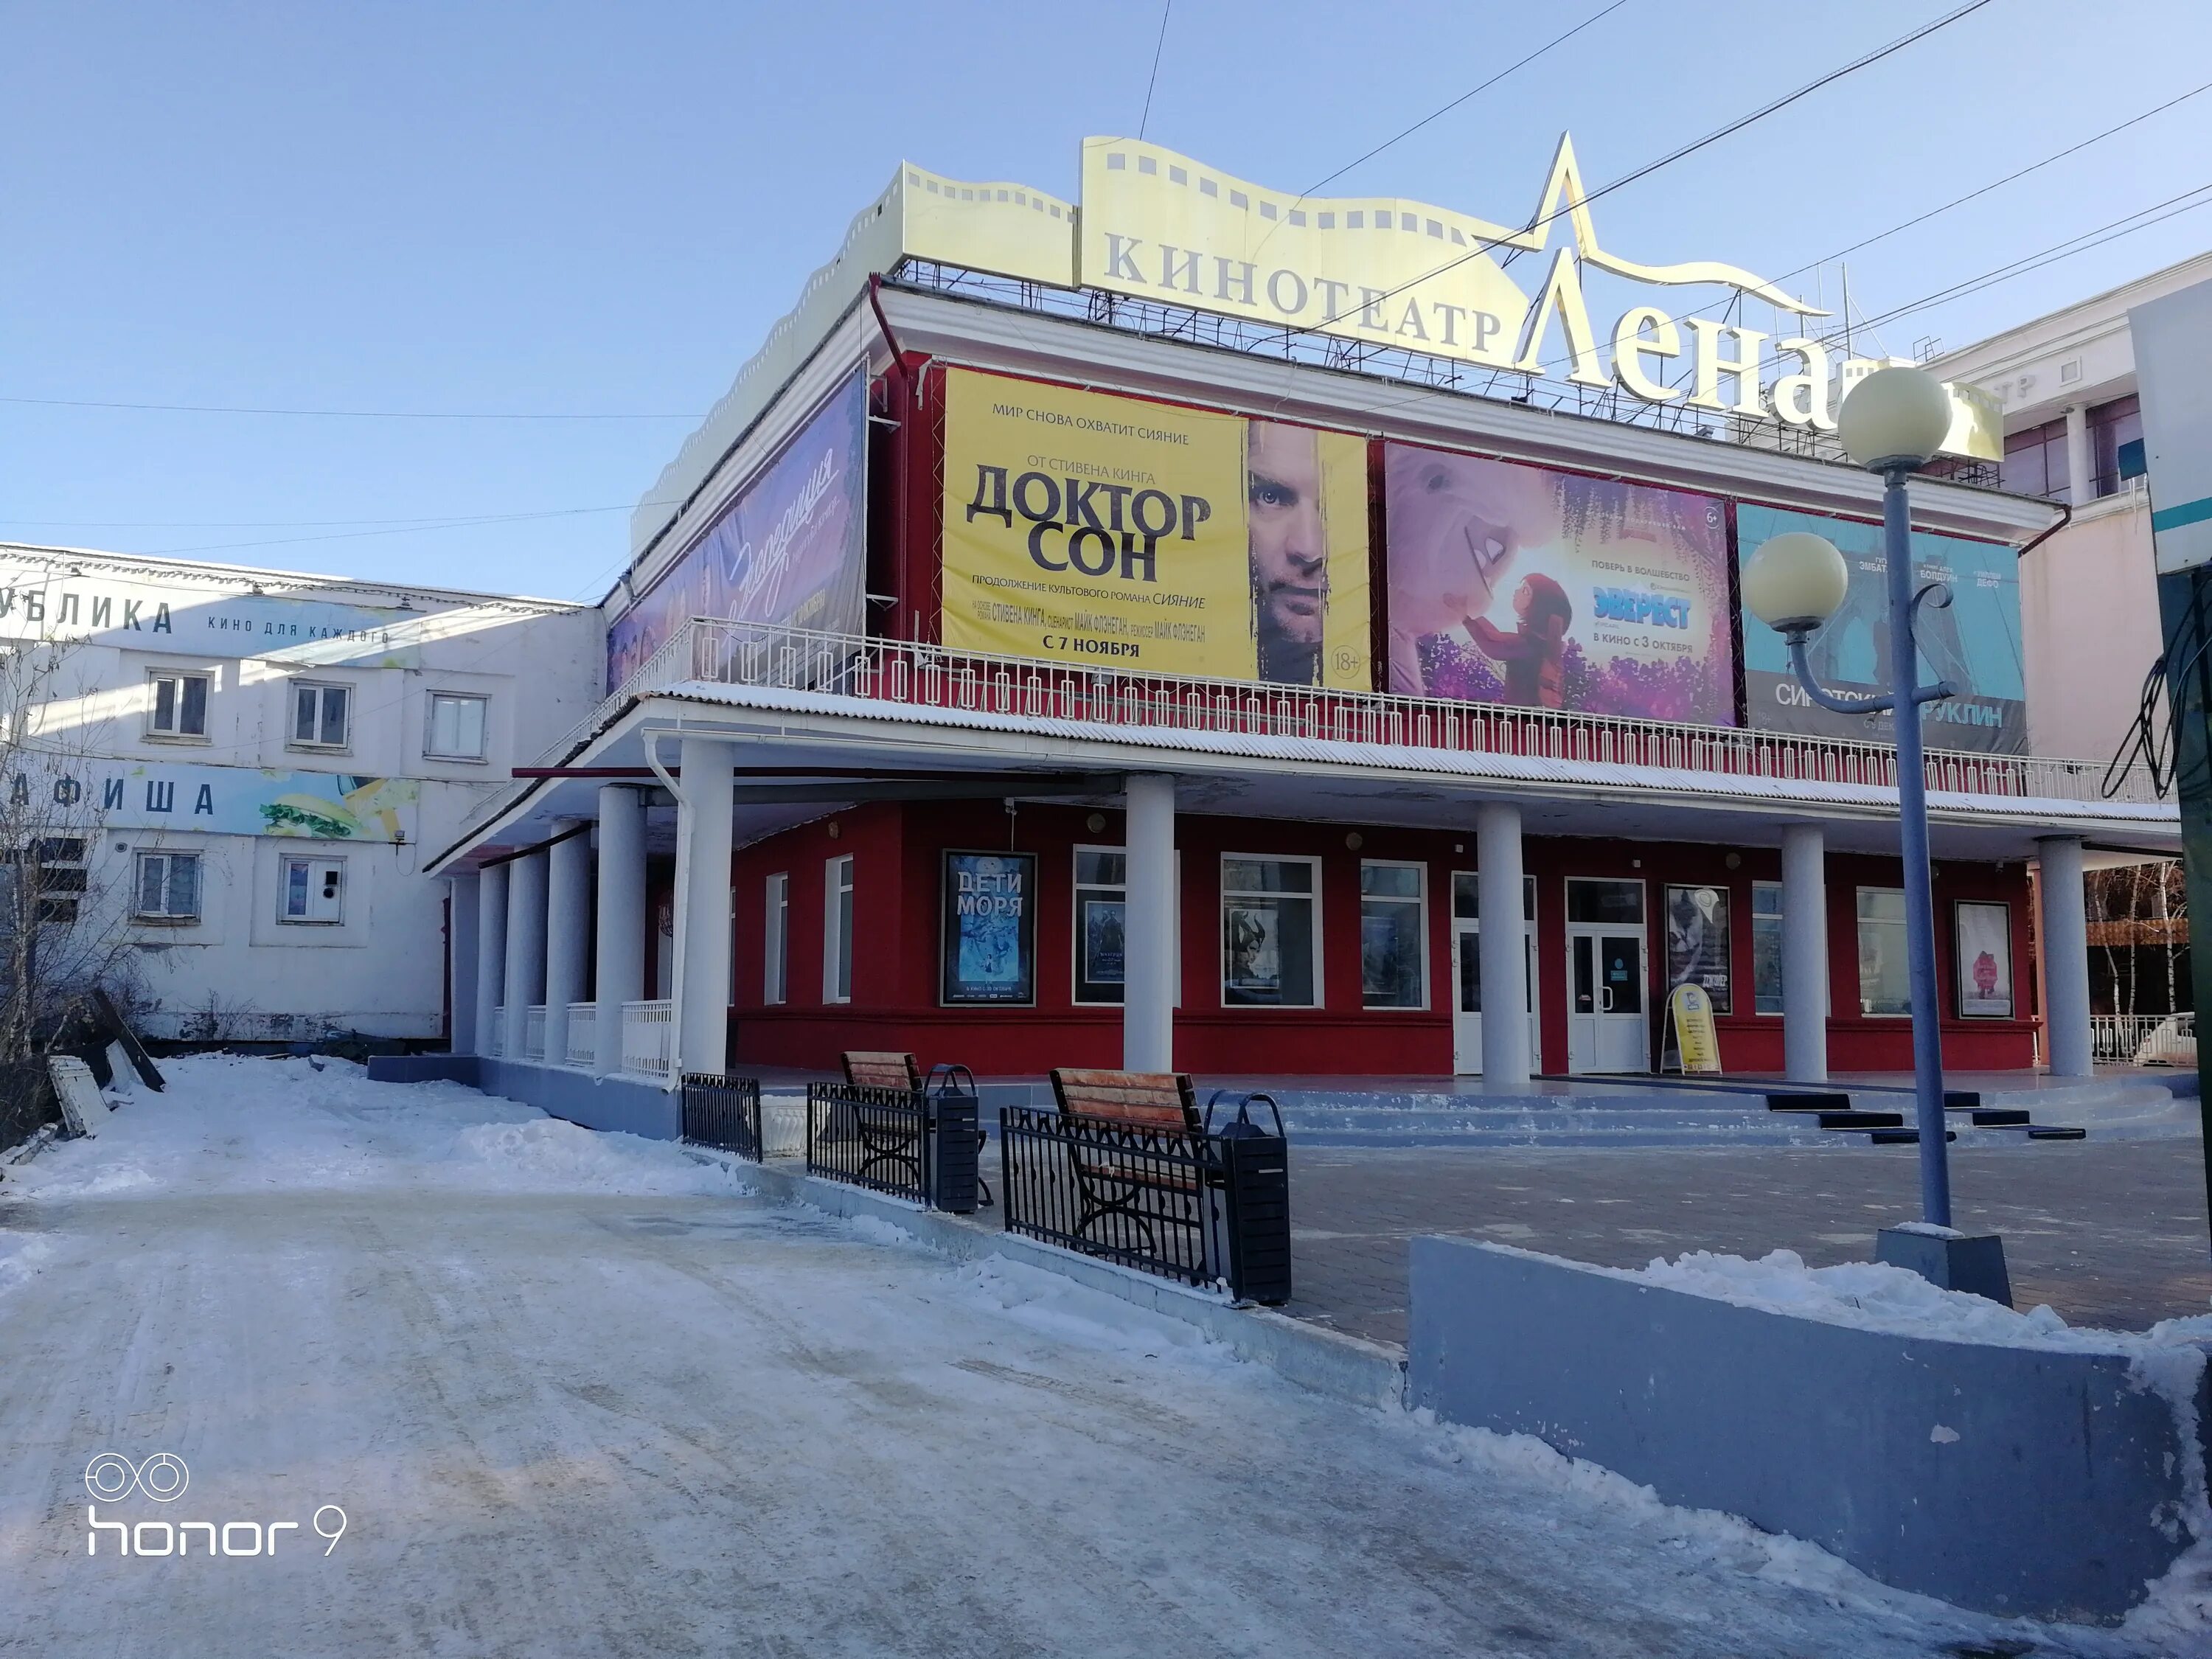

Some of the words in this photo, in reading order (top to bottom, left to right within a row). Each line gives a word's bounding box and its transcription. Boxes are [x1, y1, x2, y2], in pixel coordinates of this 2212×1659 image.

[1104, 232, 1501, 352] КИНОТЕАТР
[1512, 247, 1838, 432] Лена
[992, 403, 1023, 418] МИР
[1026, 409, 1073, 427] СНОВА
[1077, 417, 1135, 437] ОХВАТИТ
[1138, 428, 1189, 445] СИЯНИЕ
[1027, 454, 1046, 467] ОТ
[1049, 458, 1110, 478] СТИВЕНА
[1113, 467, 1156, 484] КИНГА
[966, 464, 1211, 541] ДОКТОР
[1706, 512, 1717, 523] 6+
[1028, 520, 1158, 582] СОН
[1592, 560, 1625, 572] ПОВЕРЬ
[1635, 567, 1690, 581] ВОЛШЕБСТВО
[1859, 560, 1888, 573] ЭМБАТ
[972, 574, 1046, 592] ПРОДОЛЖЕНИЕ
[1048, 584, 1109, 599] КУЛЬТОВОГО
[1110, 591, 1151, 604] РОМАНА
[1152, 593, 1206, 609] СИЯНИЕ
[1977, 577, 1999, 588] ДЕФО
[1593, 586, 1691, 630] ЭВЕРЕСТ
[209, 616, 251, 632] КИНО
[264, 622, 297, 636] ДЛЯ
[309, 626, 389, 644] КАЖДОГО
[992, 603, 1023, 625] СТИВЕНА
[1023, 606, 1047, 630] КИНГА,
[1074, 610, 1093, 632] МАЙК
[1093, 615, 1129, 639] ФЛЭНЕГАН,
[1155, 618, 1172, 640] МАЙК
[1172, 623, 1206, 643] ФЛЭНЕГАН
[1043, 635, 1054, 649] С
[1059, 637, 1068, 650] 7
[1073, 638, 1140, 658] НОЯБРЯ
[1593, 633, 1599, 641] В
[1602, 633, 1630, 645] КИНО
[1641, 636, 1649, 648] 3
[1652, 640, 1693, 653] ОКТЯБРЯ
[1335, 651, 1358, 671] 18+
[1878, 721, 1895, 731] ДЕК
[1921, 700, 2002, 728] РУКЛИН
[10, 773, 214, 815] АФИША
[958, 871, 1022, 894] ДЕТИ
[957, 894, 1023, 917] МОРЯ
